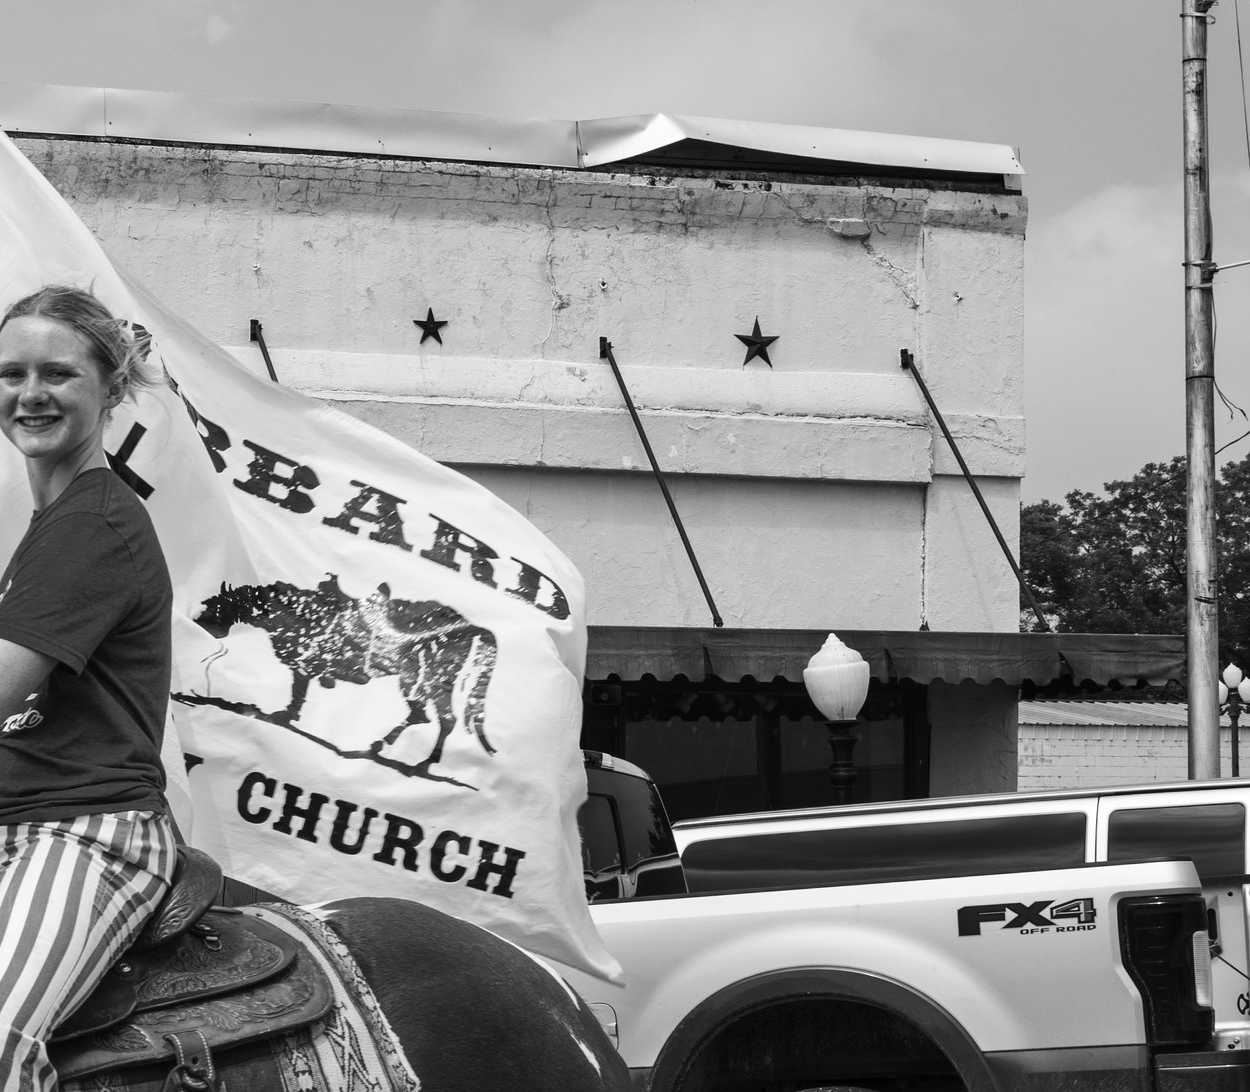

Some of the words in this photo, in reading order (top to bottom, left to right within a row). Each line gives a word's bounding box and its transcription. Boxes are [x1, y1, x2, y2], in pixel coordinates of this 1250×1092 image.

[236, 770, 526, 899] CHURCH
[957, 897, 1097, 937] FX4
[1020, 927, 1050, 935] OFF
[1056, 924, 1097, 933] ROAD
